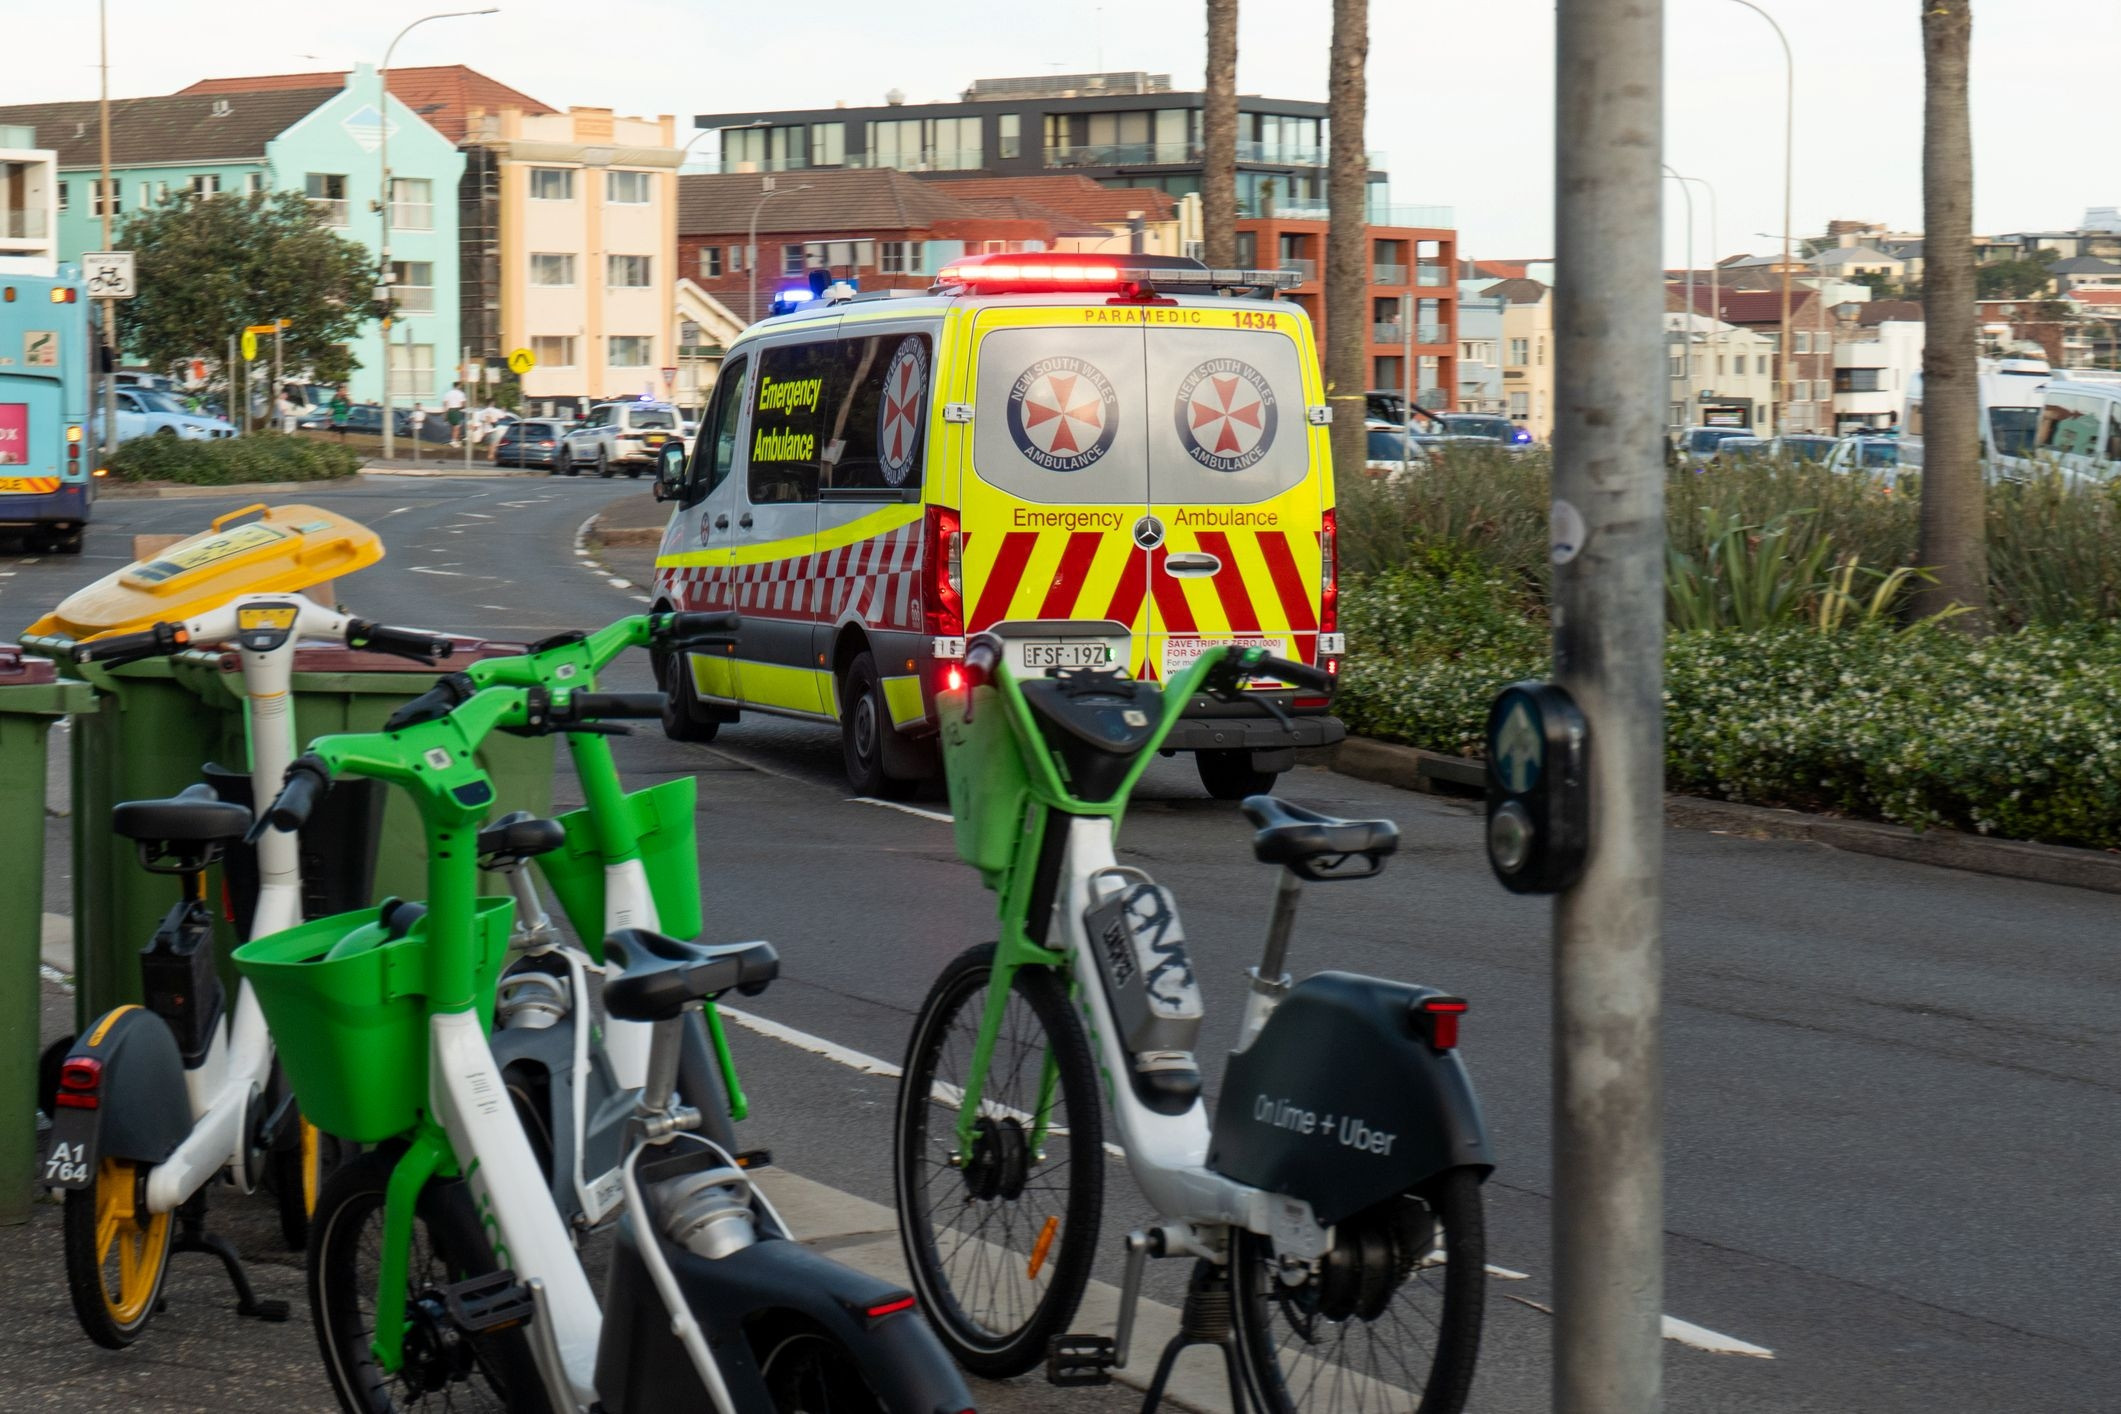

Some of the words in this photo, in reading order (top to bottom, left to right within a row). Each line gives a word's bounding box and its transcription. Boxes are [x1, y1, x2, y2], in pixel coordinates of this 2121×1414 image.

[1085, 309, 1201, 324] PARAMEDIC
[1231, 311, 1277, 330] 1434
[1011, 371, 1035, 402] NEW
[1034, 358, 1079, 376] SOUTH
[1082, 363, 1116, 405] WALES
[1178, 371, 1201, 402] NEW
[1200, 359, 1241, 377] SOUTH
[1243, 365, 1275, 406] WALES
[759, 376, 822, 416] Emergency
[753, 426, 815, 462] Ambulance
[879, 450, 914, 485] AMBULANCE
[1023, 444, 1104, 470] AMBULANCE
[1190, 446, 1265, 471] AMBULANCE
[1013, 507, 1124, 531] Emergency
[1174, 507, 1279, 527] Ambulance
[1167, 639, 1193, 648] SAVE
[1167, 649, 1187, 657] FOR
[1166, 658, 1181, 667] For
[1337, 1115, 1398, 1157] Uber
[51, 1141, 85, 1163] A1
[46, 1160, 88, 1183] 764
